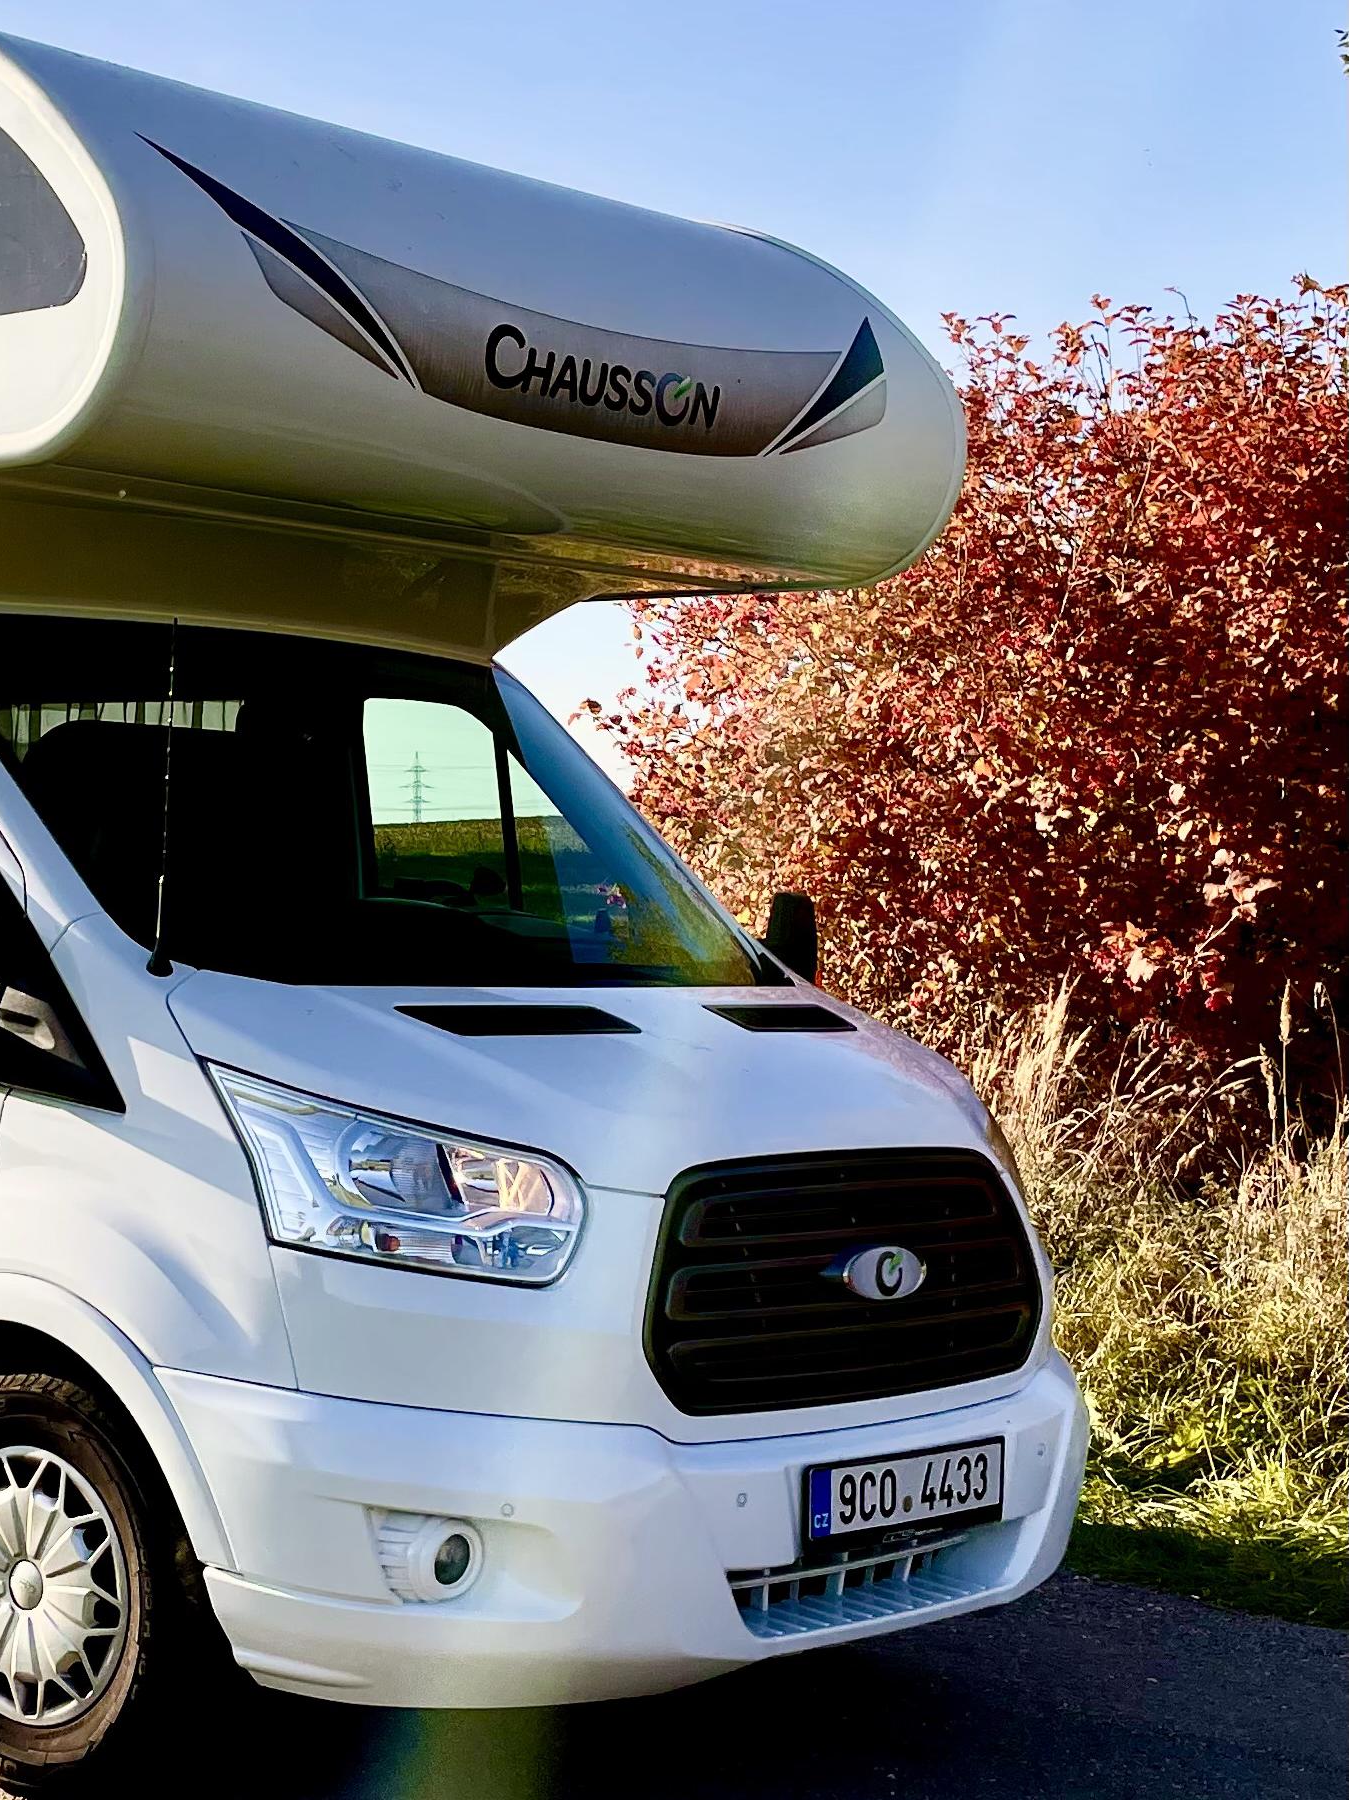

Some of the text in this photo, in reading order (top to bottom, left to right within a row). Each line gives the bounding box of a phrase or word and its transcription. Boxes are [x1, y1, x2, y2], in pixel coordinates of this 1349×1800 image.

[484, 323, 722, 430] CHAUSSON
[920, 1452, 989, 1512] 4433
[813, 1512, 830, 1529] CZ
